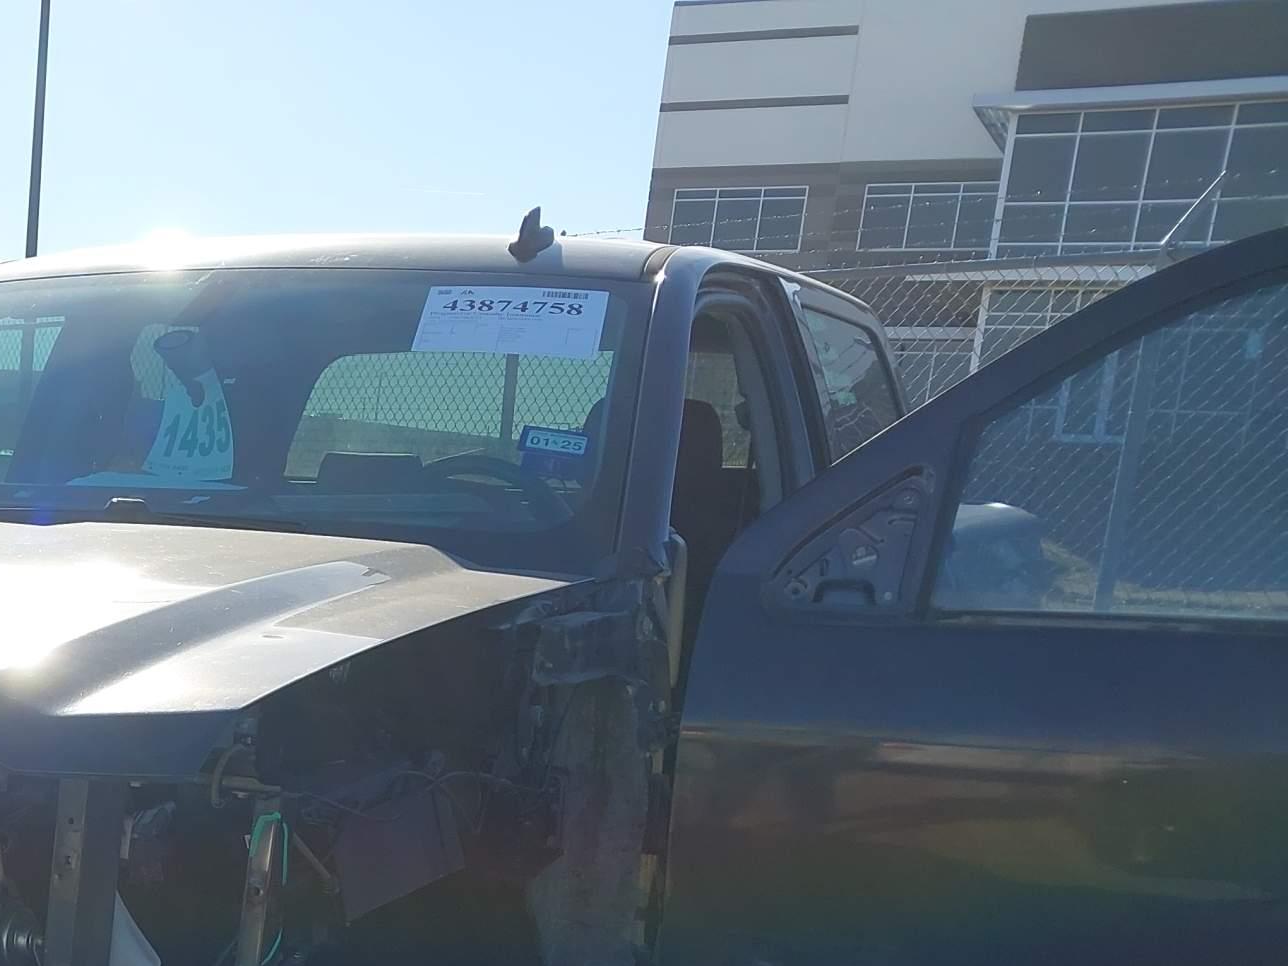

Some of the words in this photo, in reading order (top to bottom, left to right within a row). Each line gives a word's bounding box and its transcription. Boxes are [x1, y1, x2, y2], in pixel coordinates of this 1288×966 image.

[442, 298, 584, 316] 43874758
[163, 399, 231, 458] 1435
[530, 435, 550, 447] 01
[560, 439, 584, 451] 25
